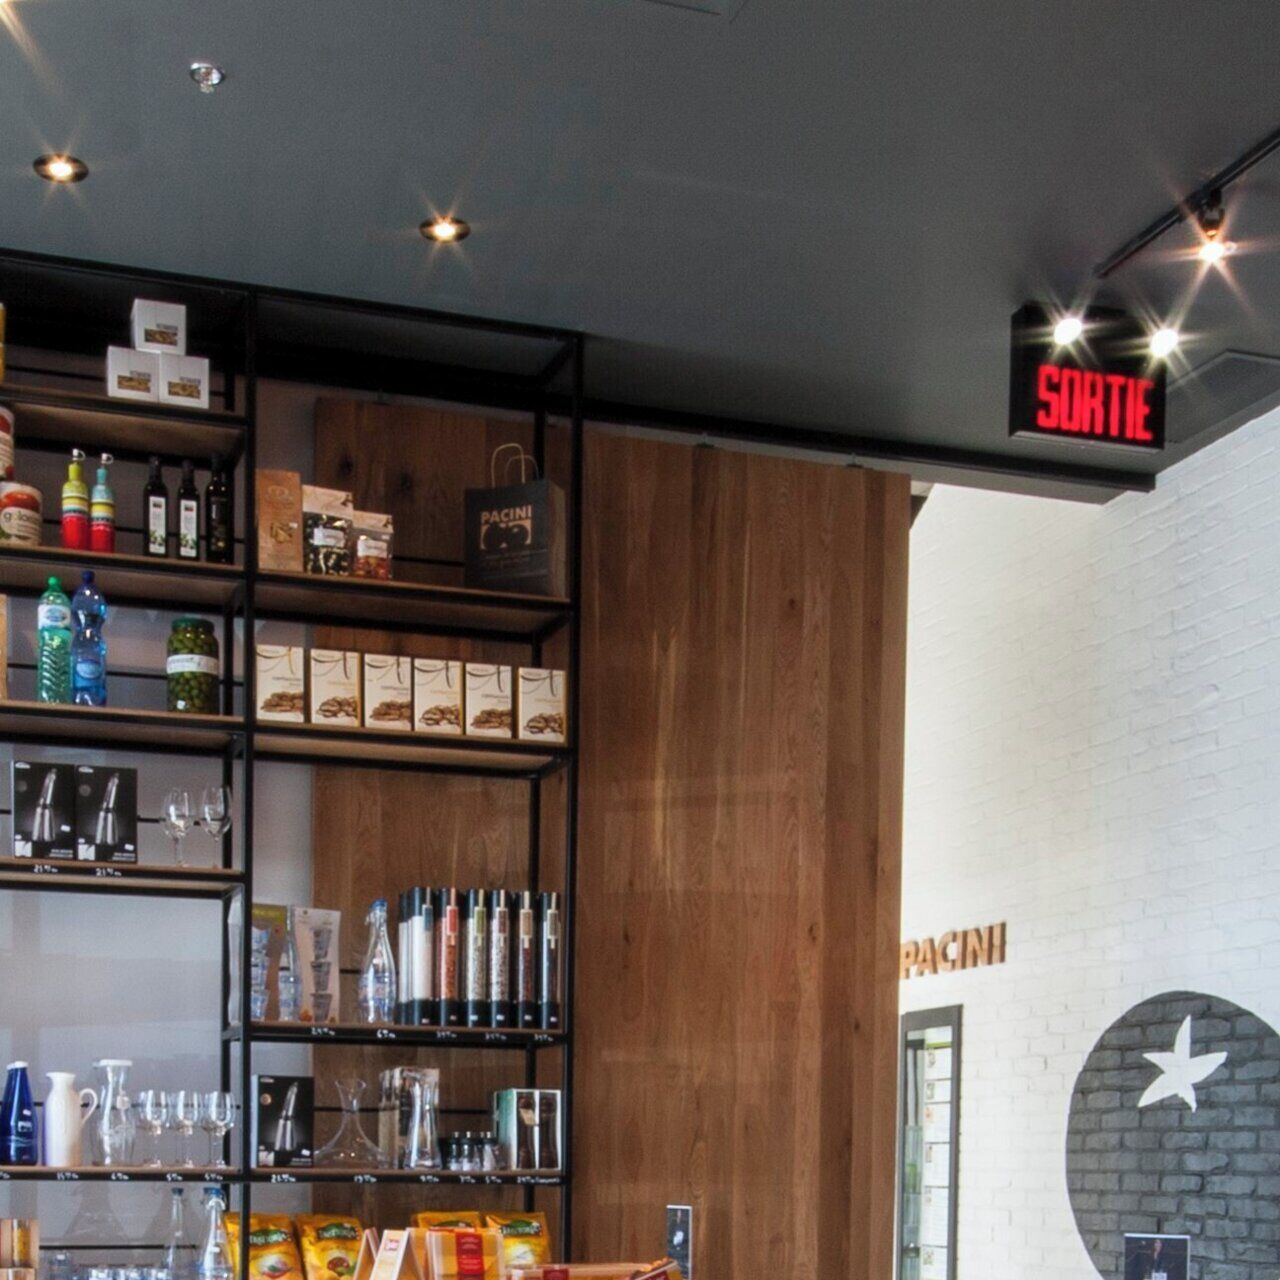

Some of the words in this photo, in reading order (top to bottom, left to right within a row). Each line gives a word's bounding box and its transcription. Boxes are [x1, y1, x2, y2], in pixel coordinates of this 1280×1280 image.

[1037, 364, 1154, 441] SORTIE
[480, 504, 532, 524] PACINI
[900, 921, 1007, 980] PACINI
